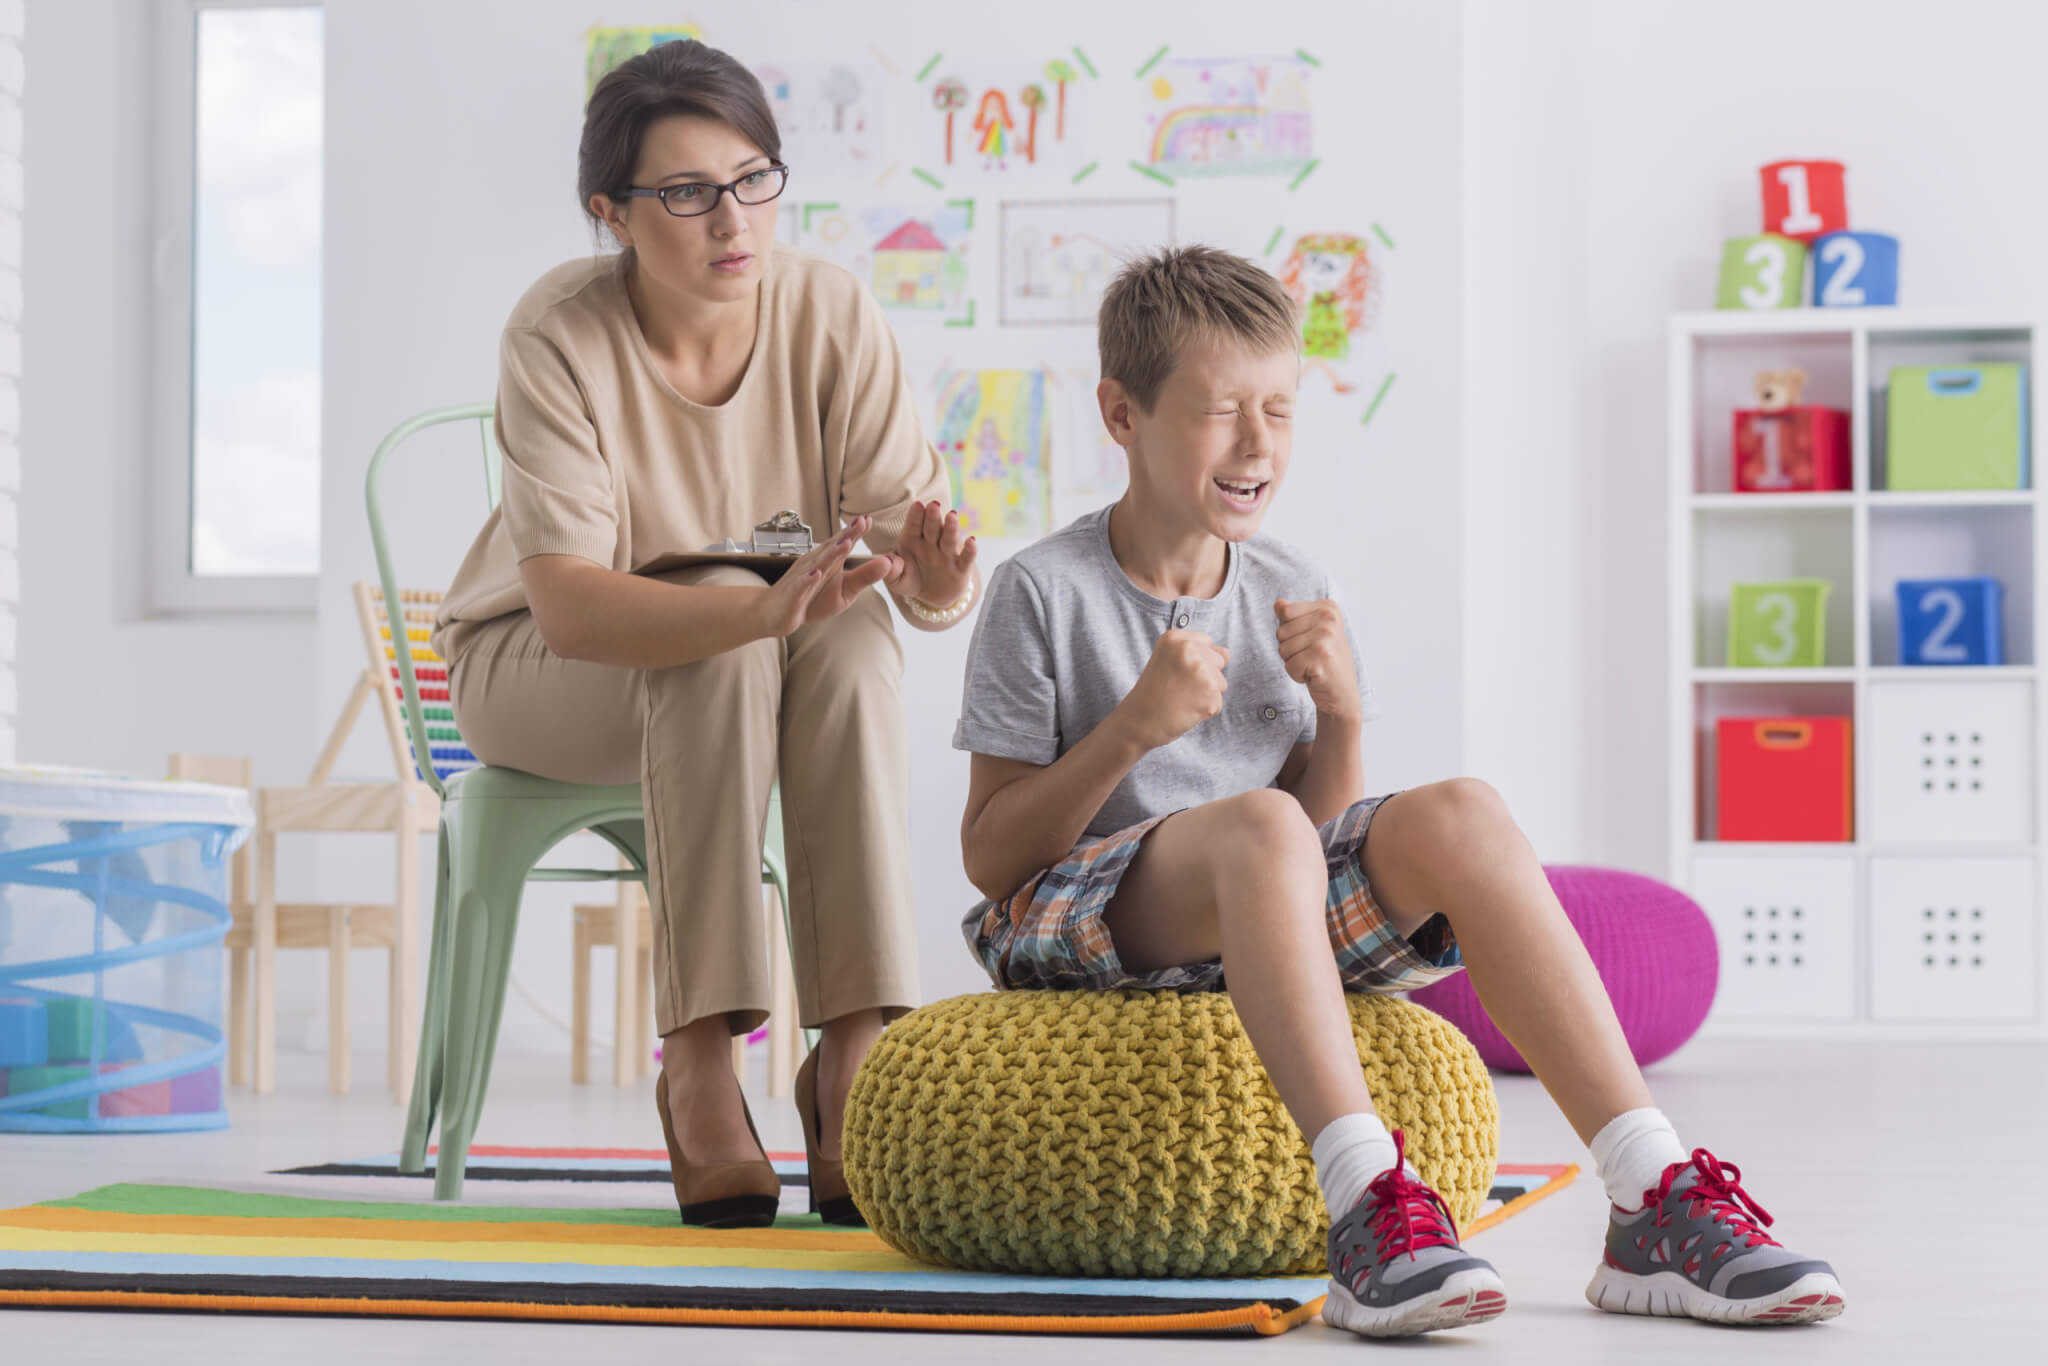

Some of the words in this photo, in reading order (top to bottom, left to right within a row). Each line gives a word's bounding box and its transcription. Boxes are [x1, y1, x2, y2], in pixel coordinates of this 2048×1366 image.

[1777, 165, 1822, 235] 1
[1740, 241, 1788, 310] 3
[1821, 237, 1866, 306] 2
[1751, 417, 1792, 488] 1
[1752, 593, 1798, 664] 3
[1919, 589, 1968, 661] 2
